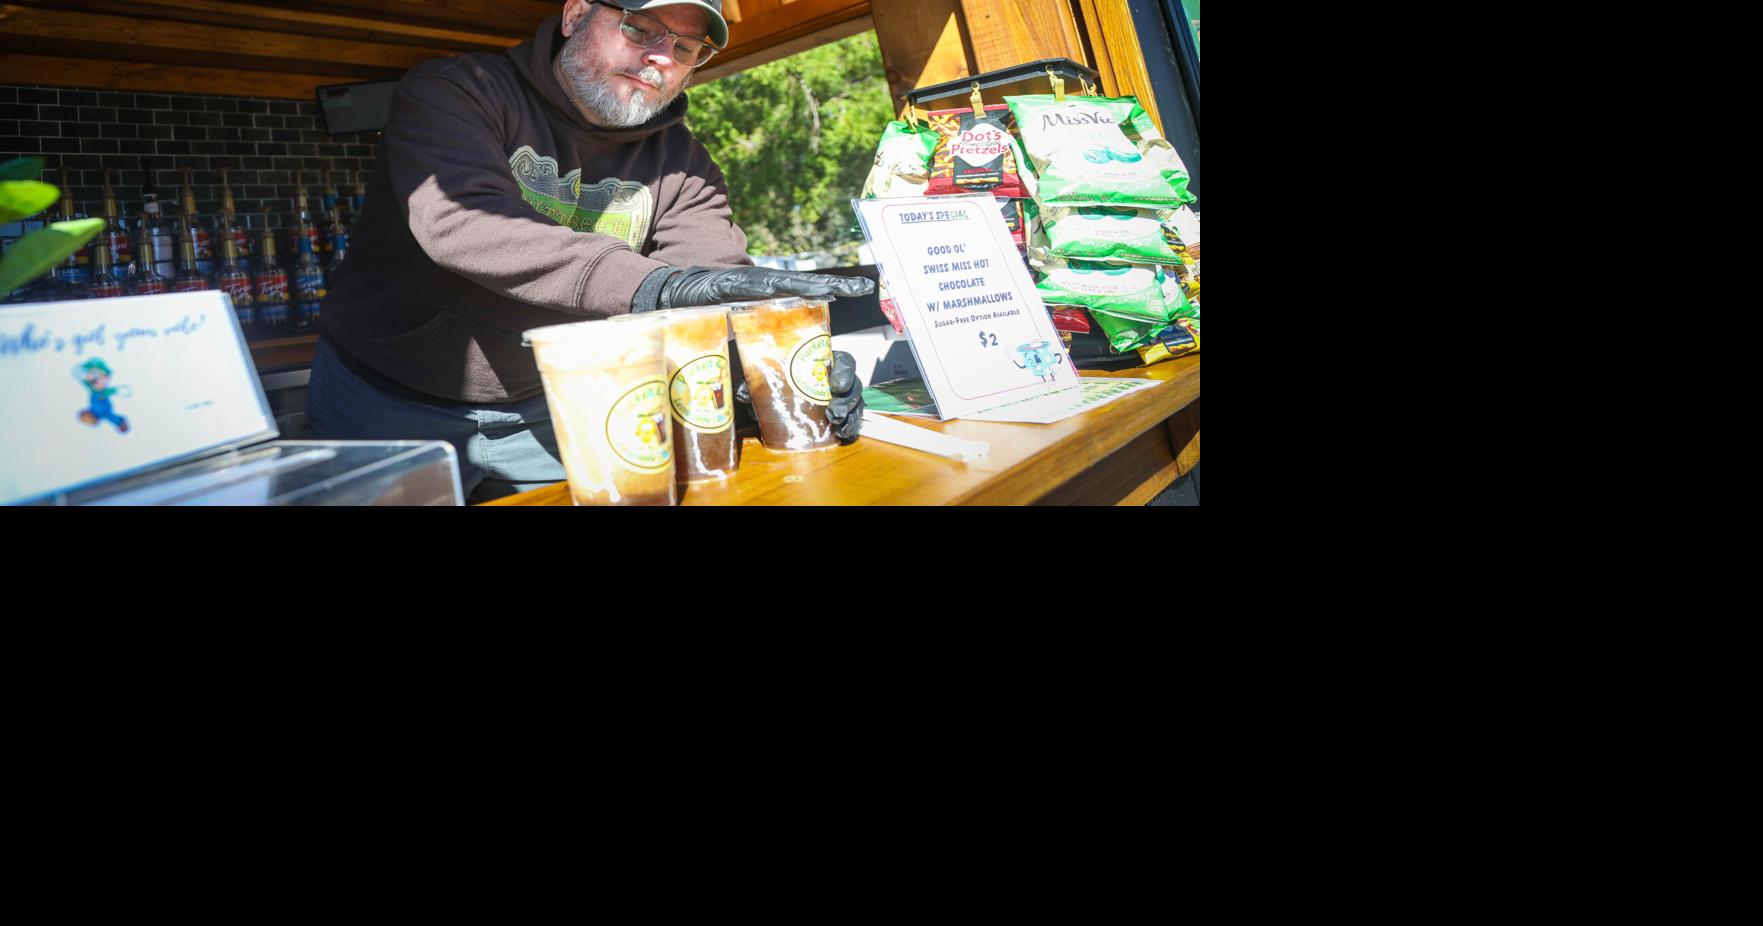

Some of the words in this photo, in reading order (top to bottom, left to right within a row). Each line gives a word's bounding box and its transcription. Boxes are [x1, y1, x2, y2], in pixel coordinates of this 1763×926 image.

[961, 130, 1002, 142] Dot's
[951, 143, 1008, 155] Pretzels
[899, 211, 934, 223] TODAY'S
[936, 210, 969, 221] SPECIAL
[927, 245, 952, 256] GOOD
[923, 263, 949, 275] SWISS
[952, 261, 972, 272] MISS
[974, 259, 990, 269] HOT
[938, 277, 986, 292] CHOCOLATE
[927, 301, 941, 313] W/
[943, 291, 1013, 311] MARSHMALLOWS
[979, 330, 999, 349] $2
